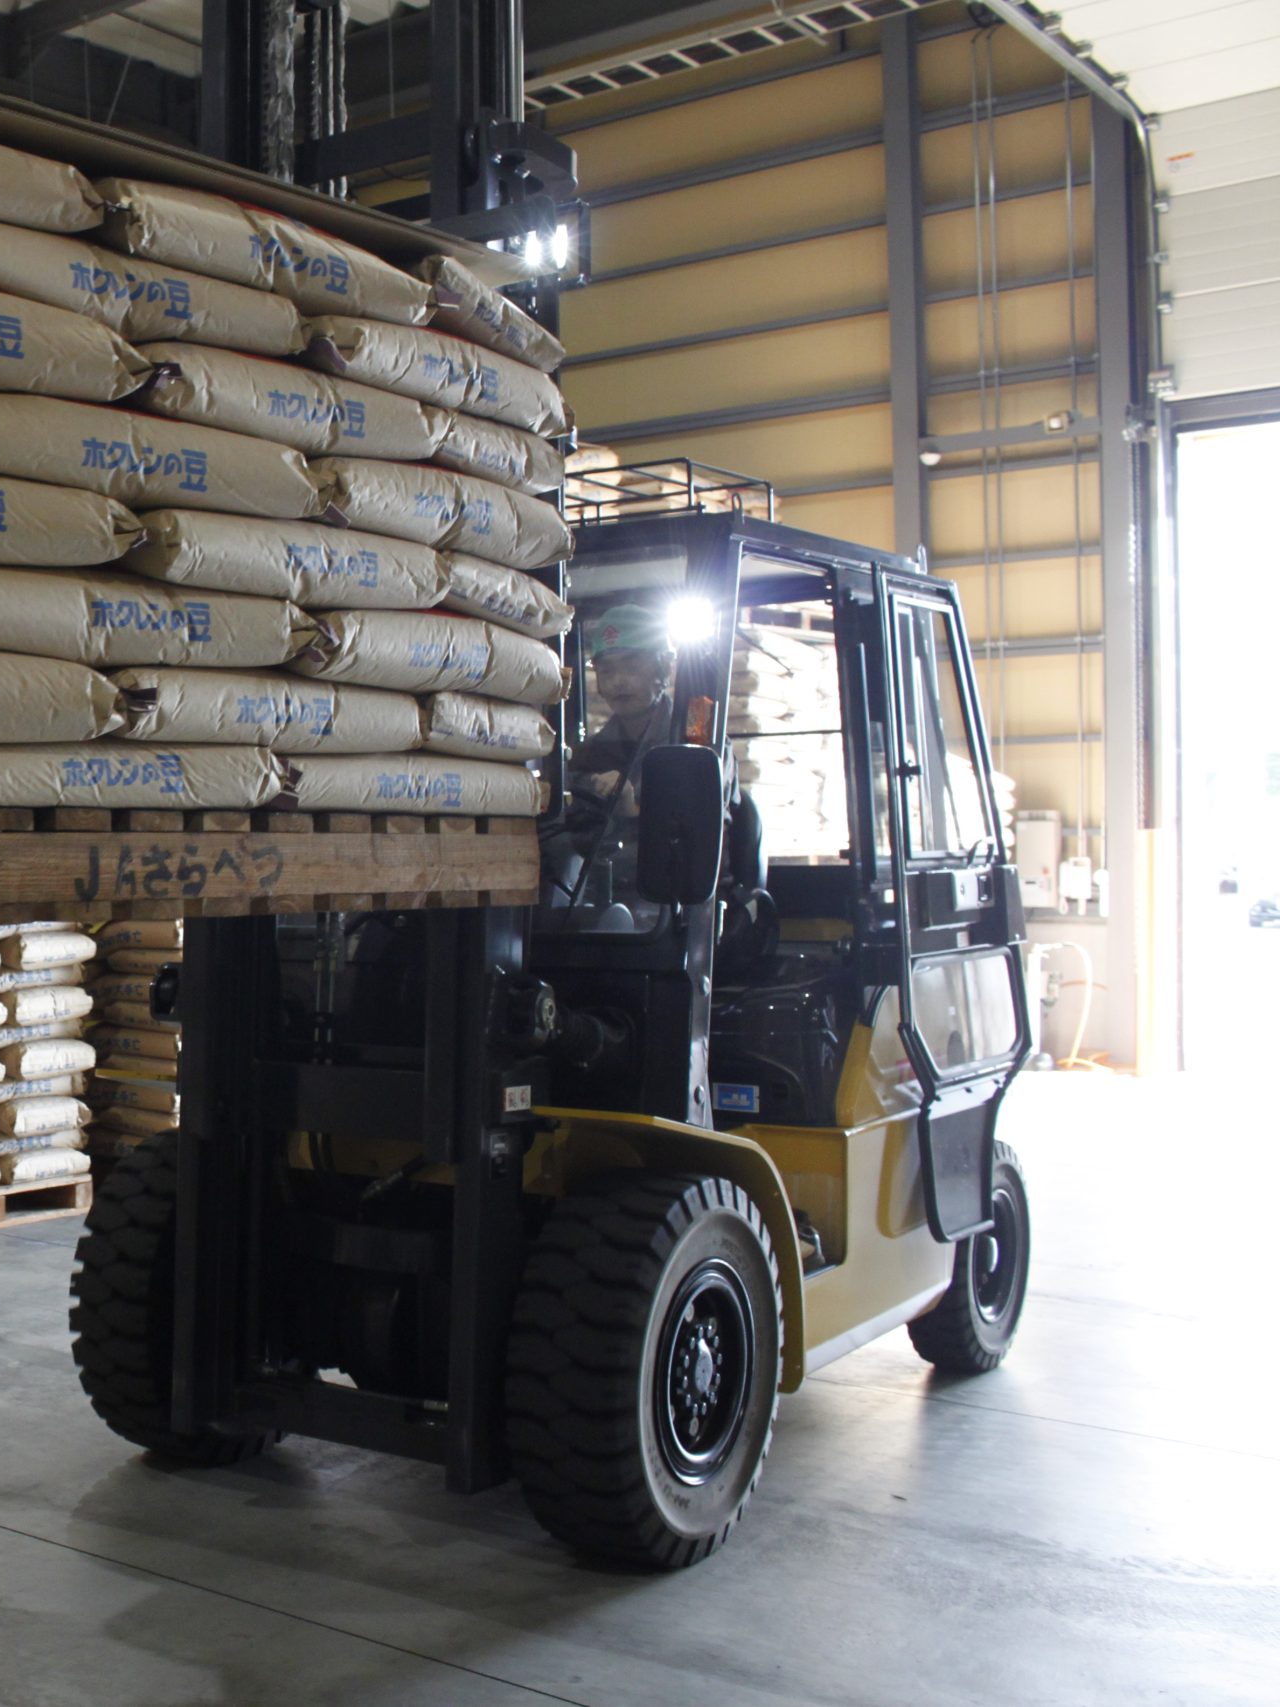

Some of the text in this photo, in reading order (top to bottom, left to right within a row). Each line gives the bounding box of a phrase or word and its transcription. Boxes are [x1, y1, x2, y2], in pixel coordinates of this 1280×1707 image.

[70, 262, 192, 320] ホクレンの豆
[81, 437, 208, 492] ホクレンの豆
[91, 599, 212, 642] ホクレンの豆
[63, 754, 185, 793] ホクレンの豆
